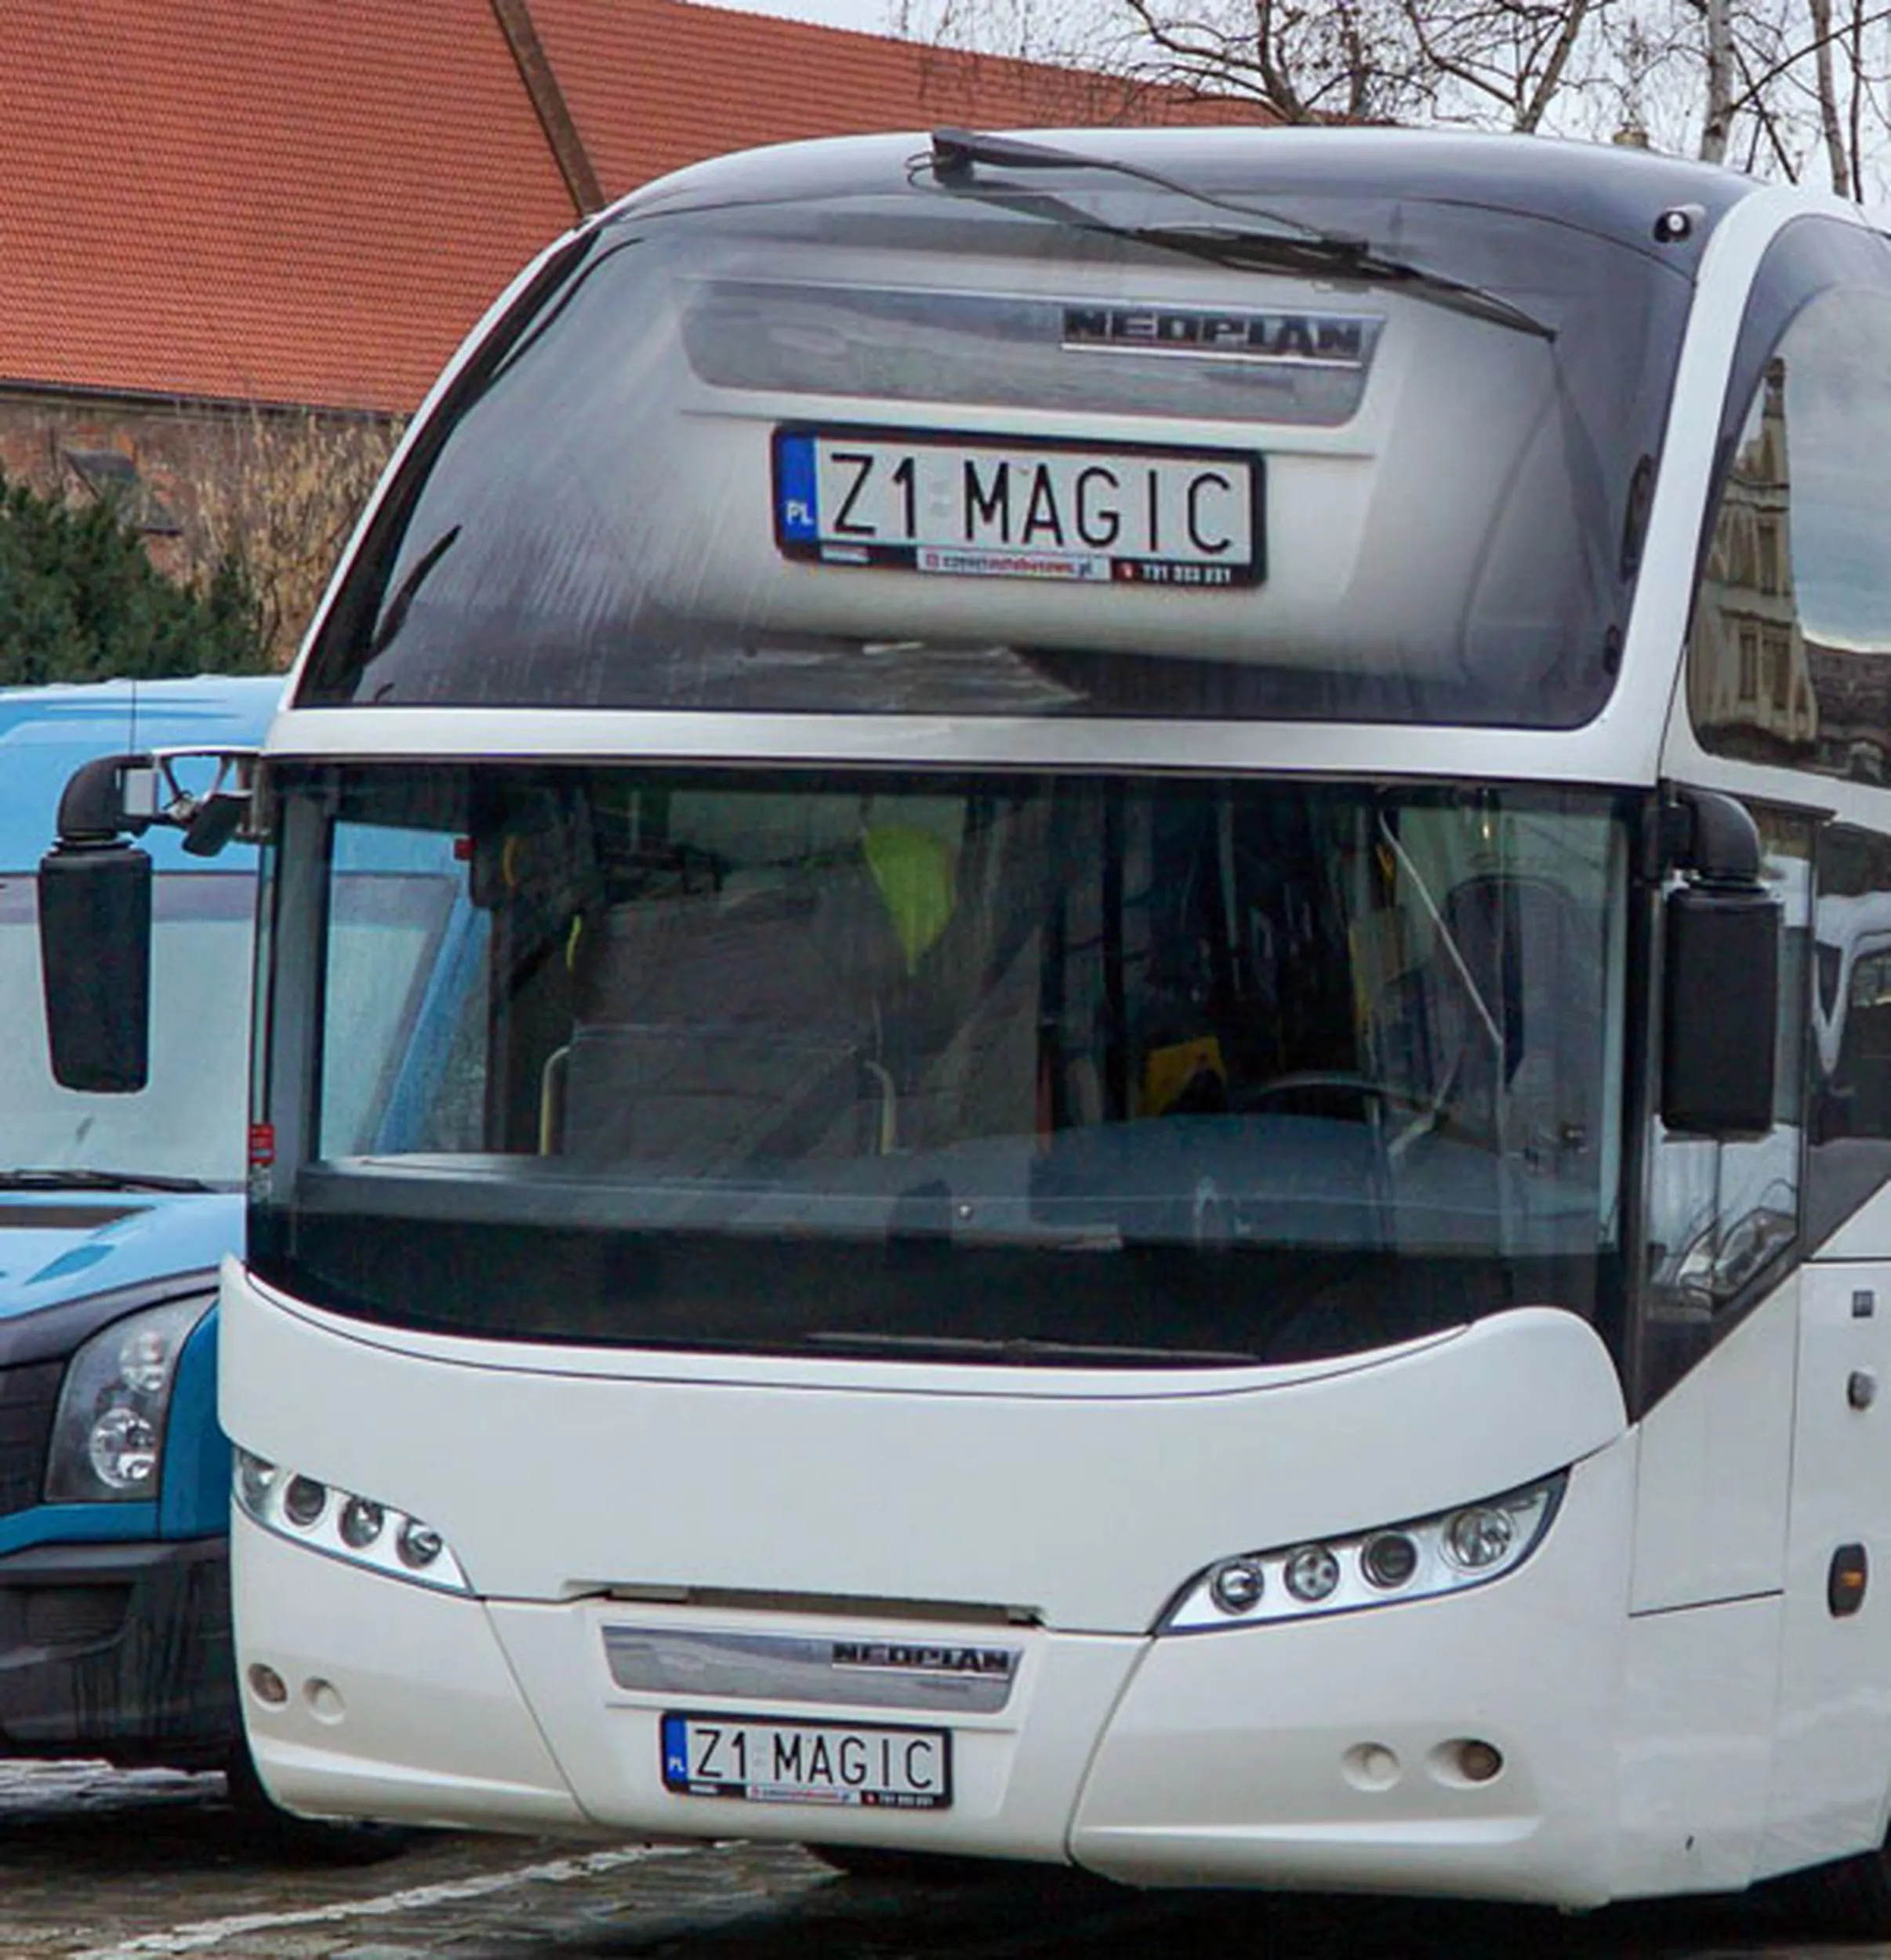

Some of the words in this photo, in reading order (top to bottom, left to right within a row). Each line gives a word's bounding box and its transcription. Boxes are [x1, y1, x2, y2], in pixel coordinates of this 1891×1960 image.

[1063, 308, 1362, 356] NEOPLAN
[786, 503, 814, 525] PL
[829, 452, 916, 539] Z1
[964, 459, 1232, 555] MAGIC
[833, 1643, 1009, 1671] NEOPLAN
[695, 1729, 746, 1779] Z1
[774, 1733, 933, 1790] MAGIC
